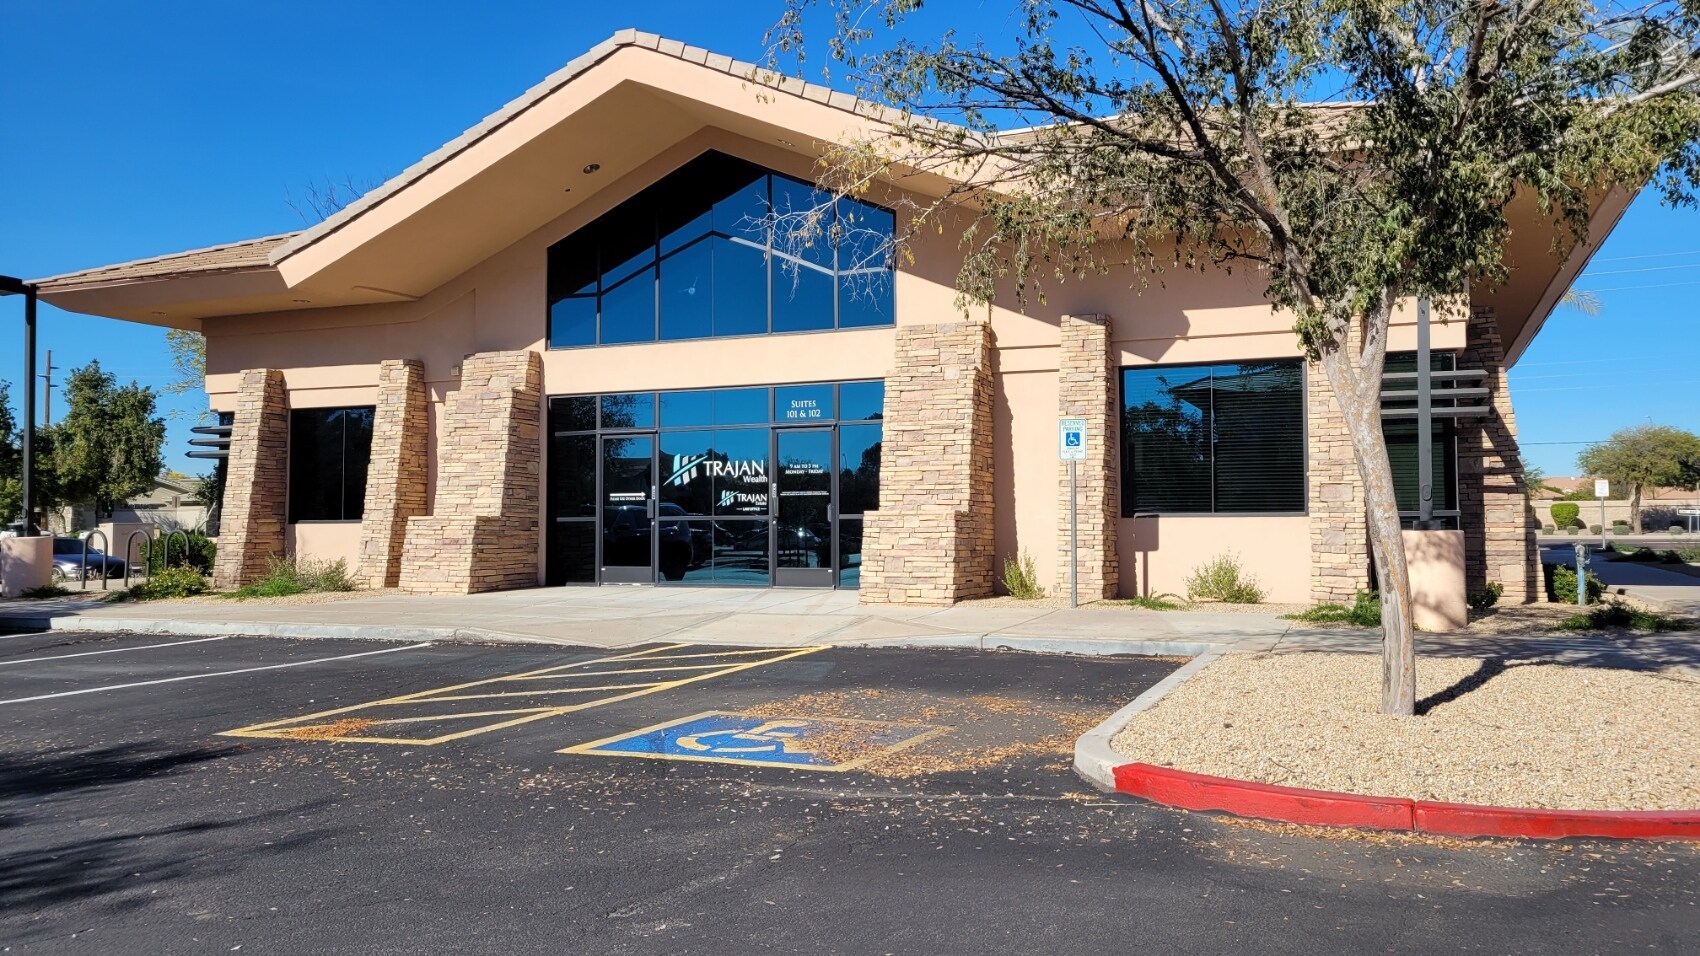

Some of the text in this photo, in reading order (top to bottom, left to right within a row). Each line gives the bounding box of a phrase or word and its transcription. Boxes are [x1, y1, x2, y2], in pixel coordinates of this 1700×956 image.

[791, 400, 816, 408] SUITES
[787, 409, 821, 418] 101 & 102
[703, 460, 764, 478] TRAJAN
[736, 494, 767, 503] TRAJAN
